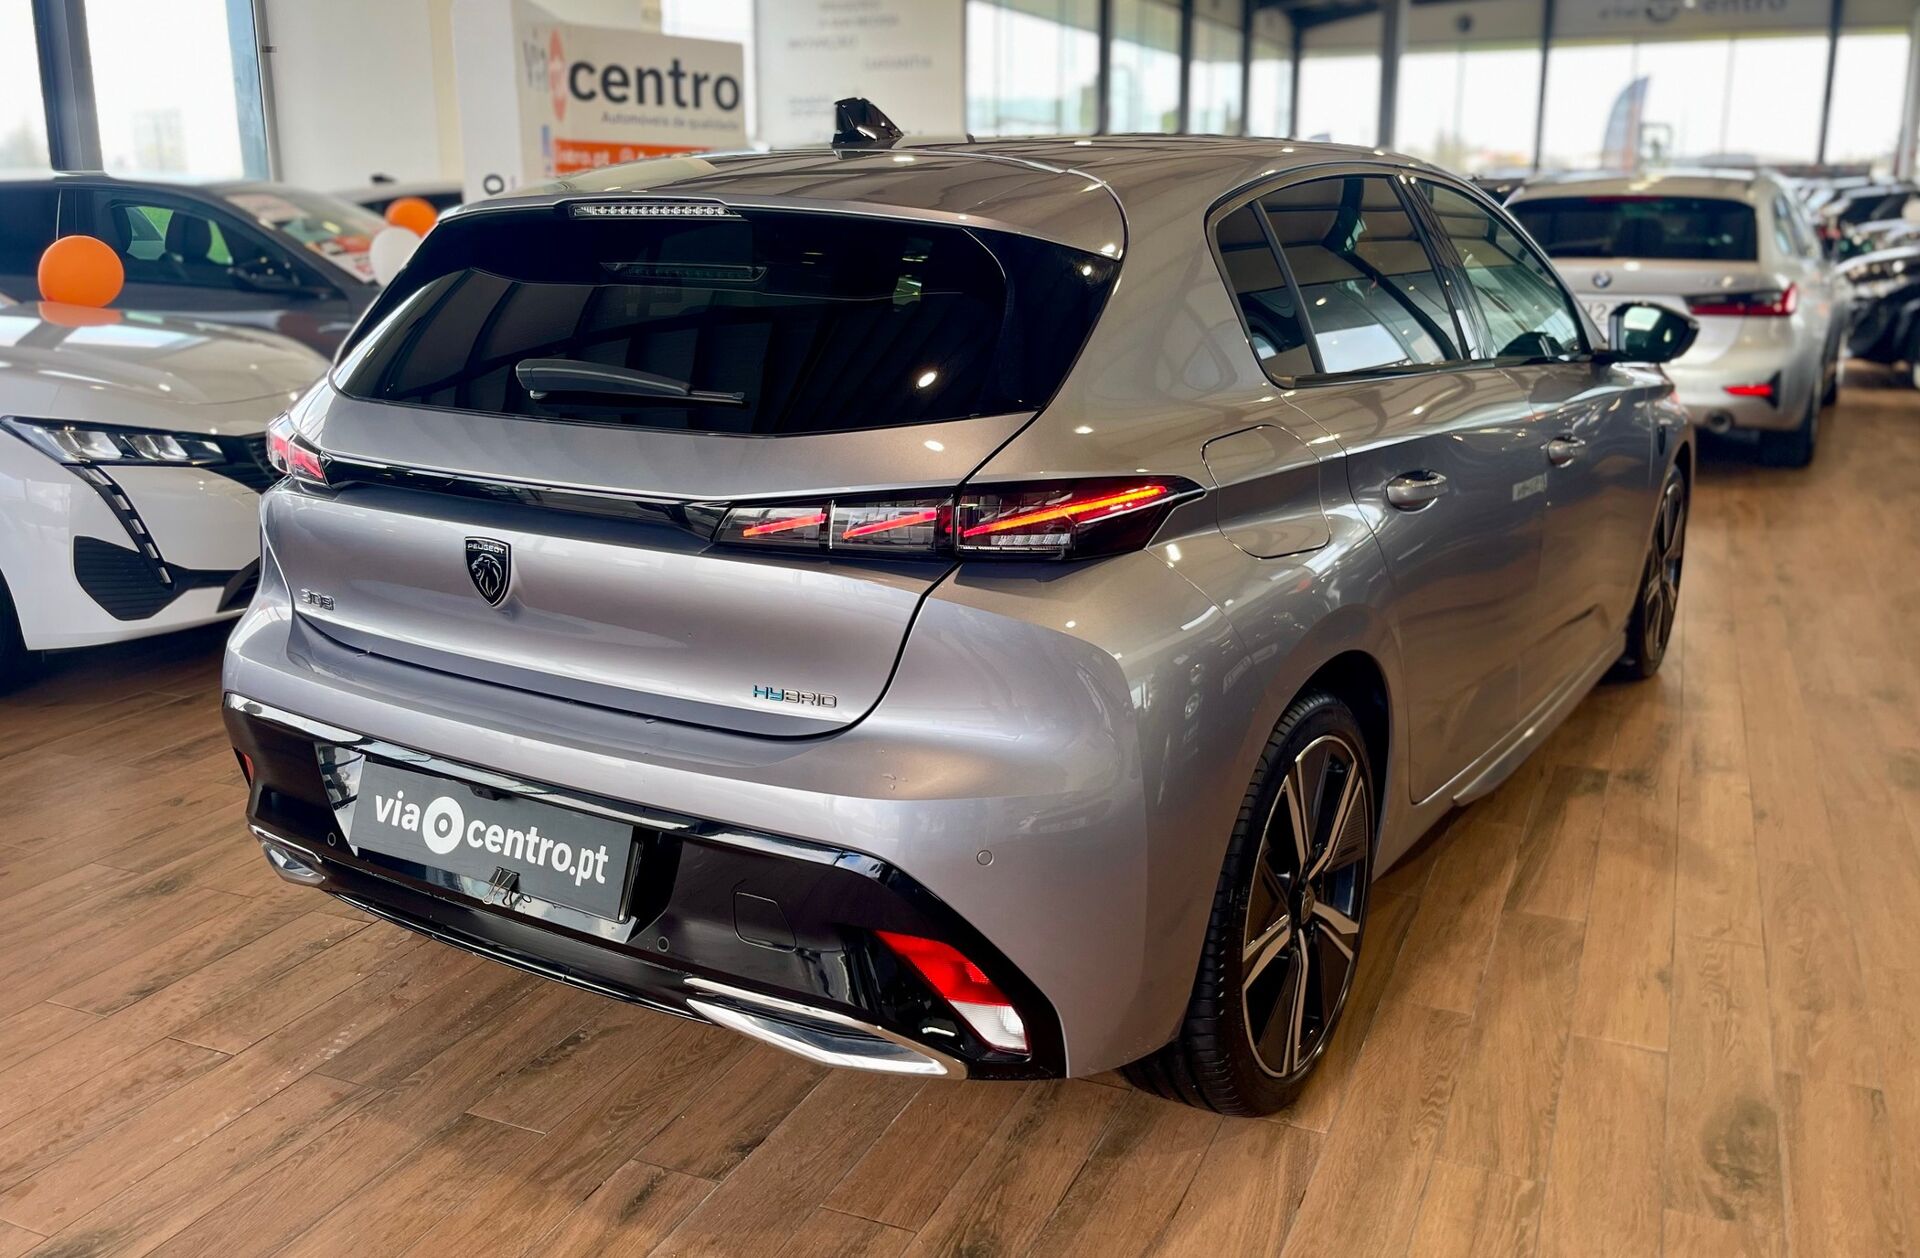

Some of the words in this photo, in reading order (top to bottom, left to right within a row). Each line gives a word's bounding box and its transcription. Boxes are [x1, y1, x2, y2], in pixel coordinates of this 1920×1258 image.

[568, 57, 740, 112] centro
[467, 543, 505, 554] PEUGEOT
[752, 684, 838, 709] HYBRID
[375, 790, 421, 832] via
[466, 819, 608, 887] centro.pt
